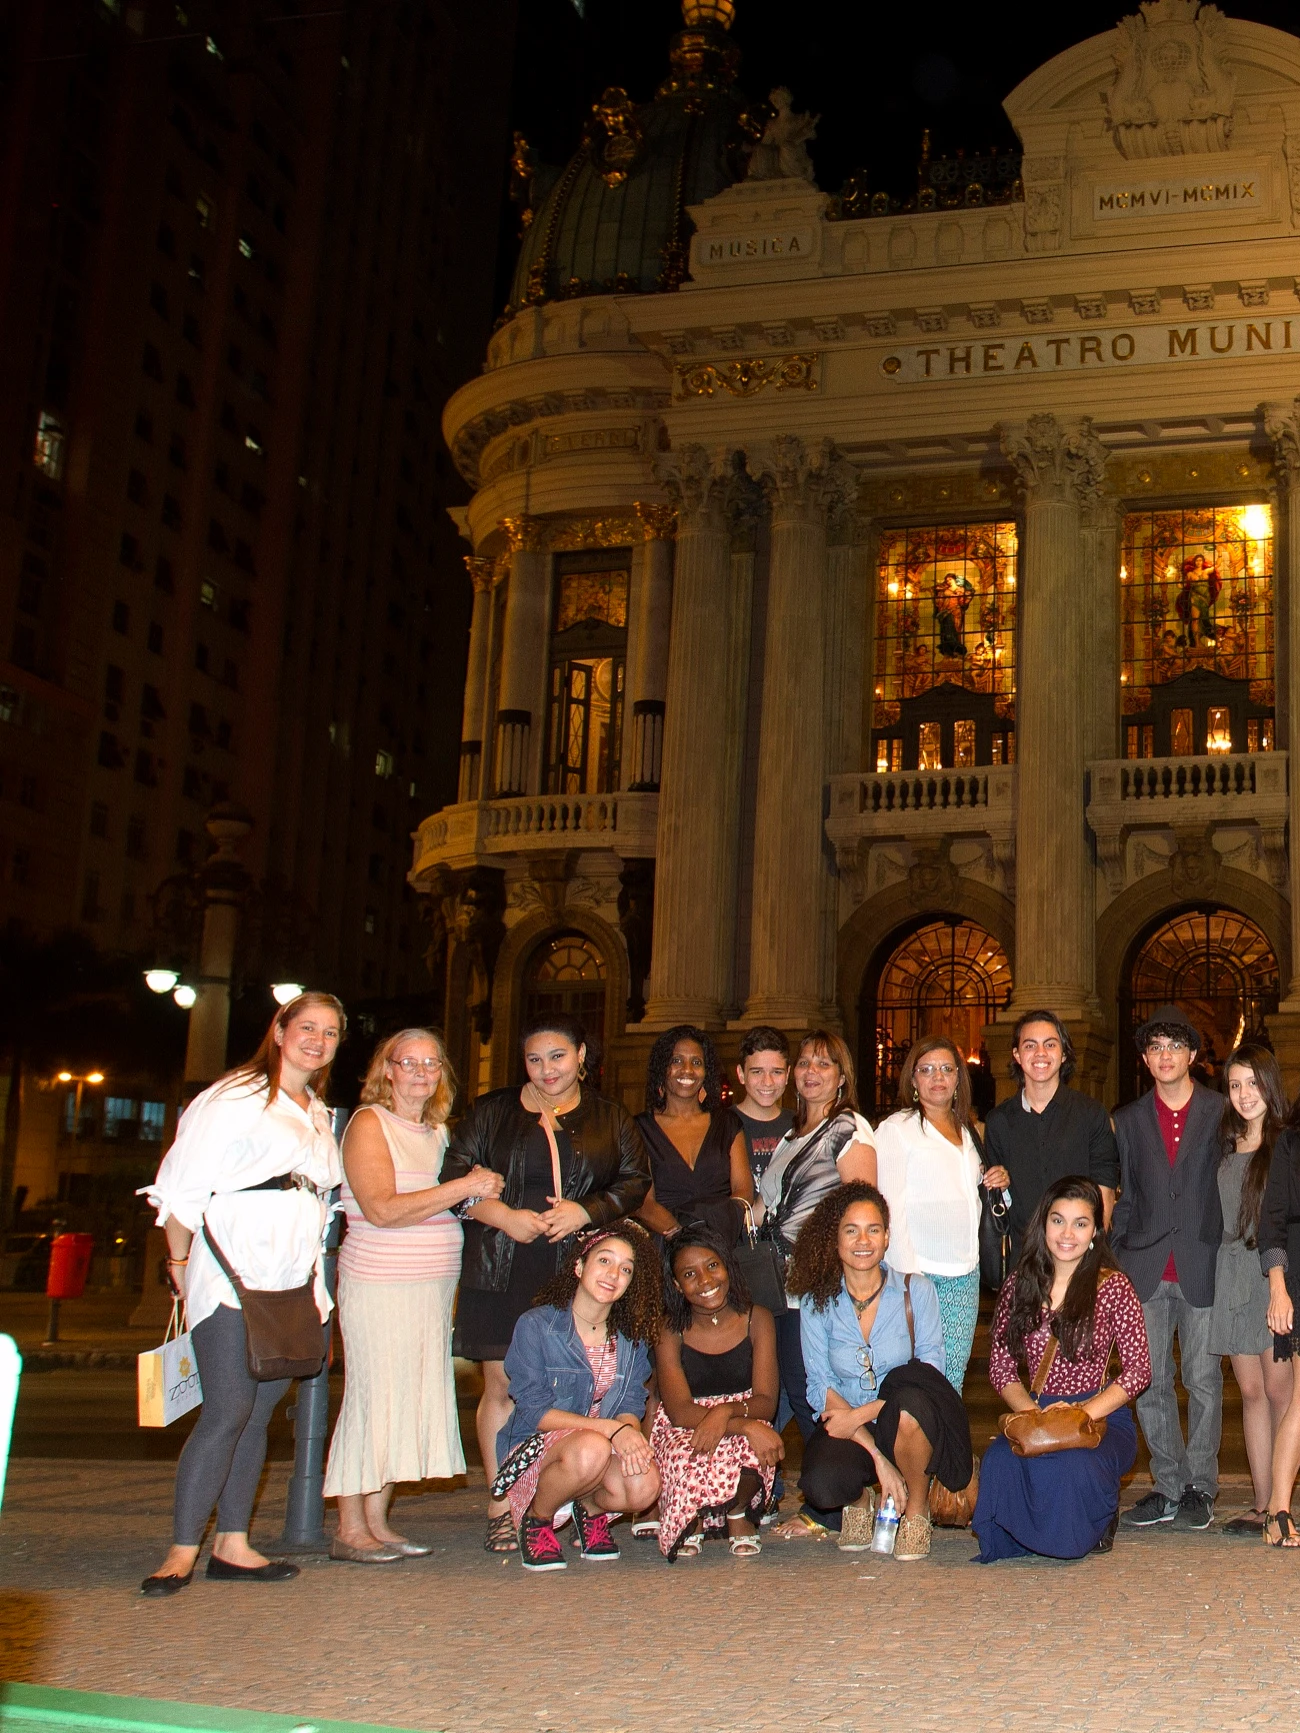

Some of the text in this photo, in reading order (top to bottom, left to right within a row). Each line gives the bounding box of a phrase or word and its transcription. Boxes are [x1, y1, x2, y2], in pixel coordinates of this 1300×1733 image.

[1099, 182, 1255, 211] MCMVI-MCMIX
[709, 236, 801, 259] MUSICA
[916, 333, 1136, 377] THEATRO
